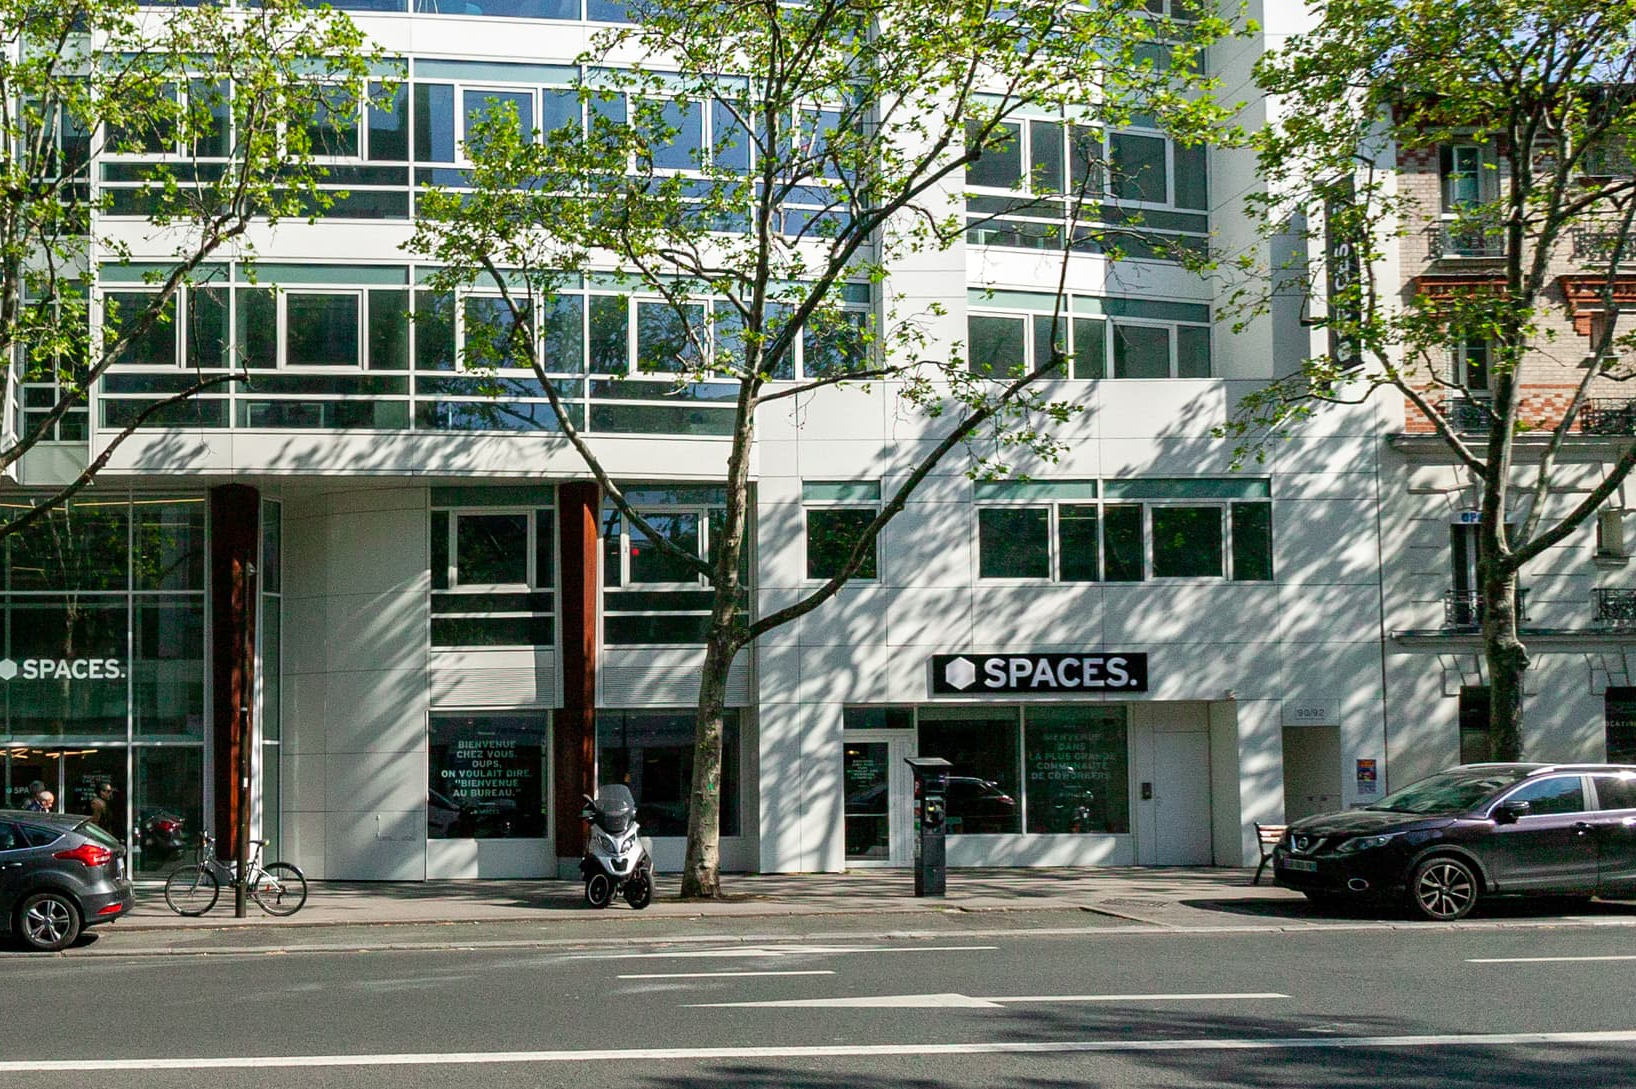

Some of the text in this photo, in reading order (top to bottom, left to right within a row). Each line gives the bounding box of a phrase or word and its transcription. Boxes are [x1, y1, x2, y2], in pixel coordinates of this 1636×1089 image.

[22, 659, 126, 680] SPACES.
[984, 657, 1138, 688] SPACES.
[458, 740, 516, 749] BIENVENUE
[456, 750, 484, 759] CHEZ
[1045, 753, 1071, 761] PLUS
[441, 770, 456, 778] ON
[459, 769, 503, 778] VOULAIT
[1030, 772, 1046, 780] DE
[453, 789, 468, 798] AU
